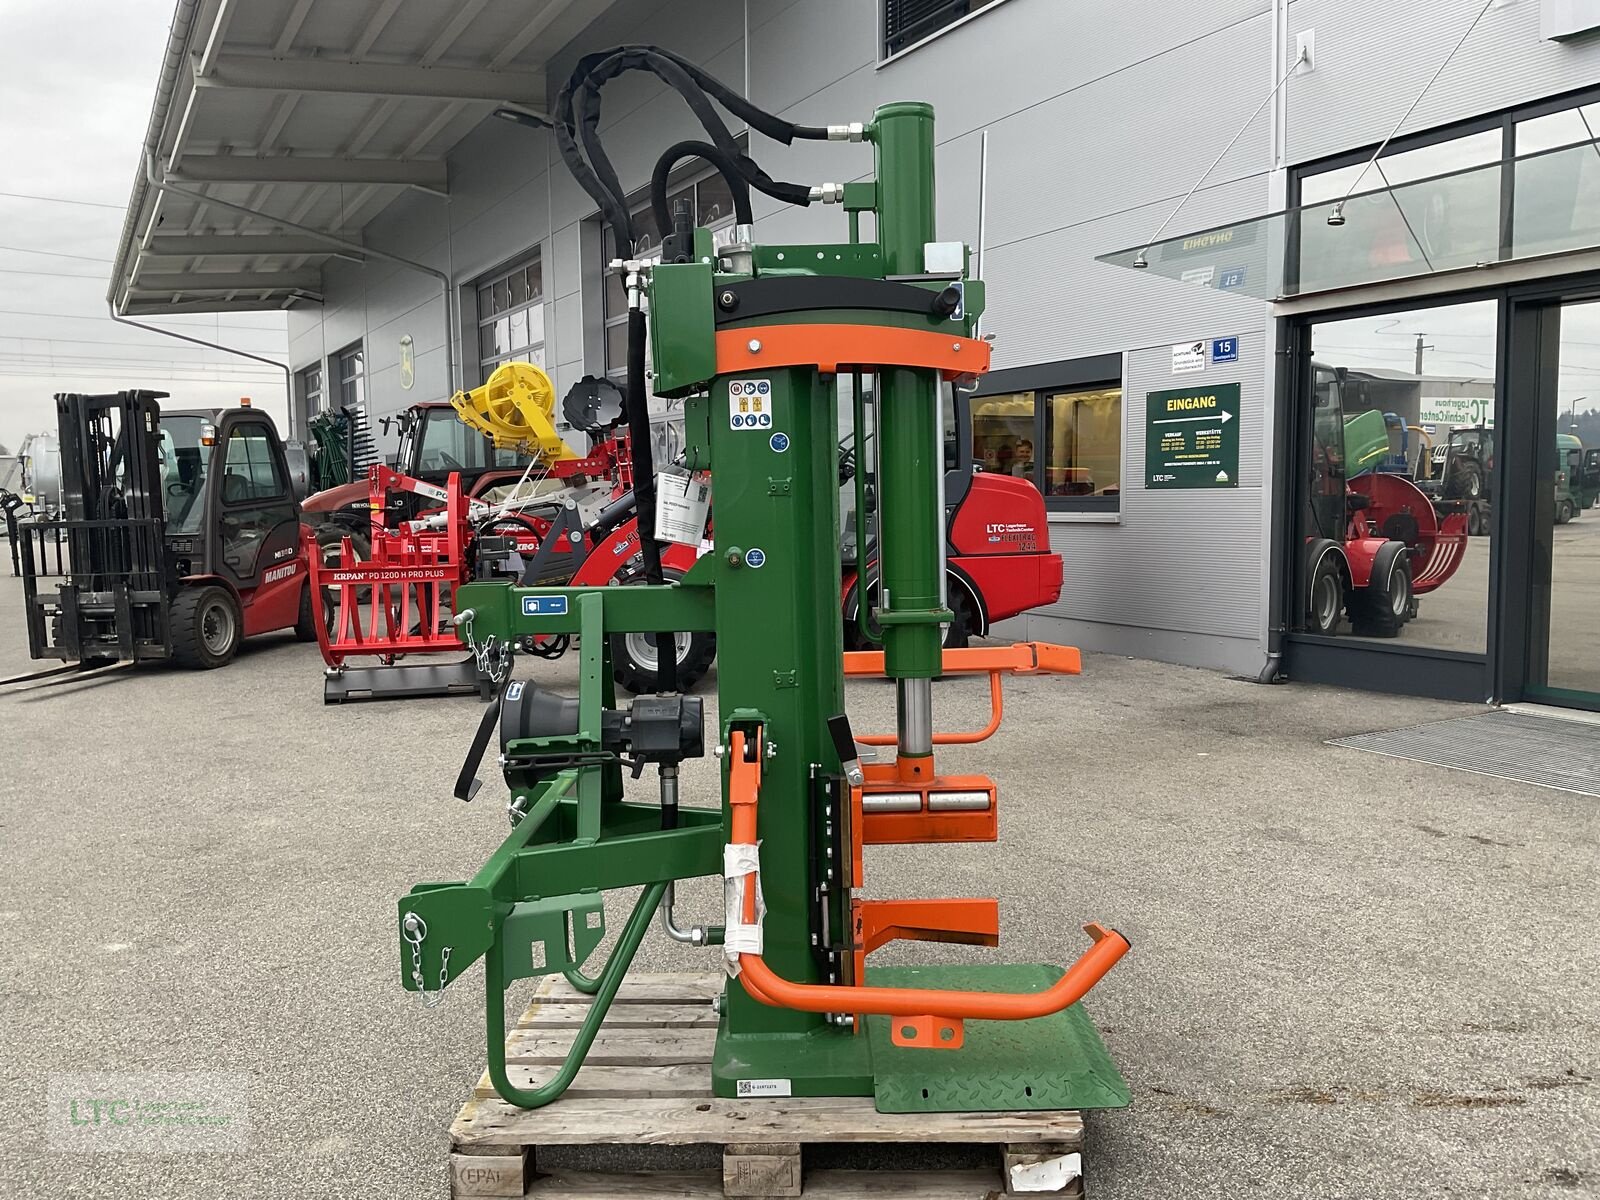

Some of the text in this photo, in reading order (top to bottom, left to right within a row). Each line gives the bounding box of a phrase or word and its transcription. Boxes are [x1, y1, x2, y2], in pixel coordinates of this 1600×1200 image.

[1218, 341, 1231, 353] 15
[1167, 396, 1216, 411] EINGANG
[986, 524, 1005, 533] LTC
[264, 563, 297, 584] MANITOU
[381, 571, 400, 579] 1200
[408, 570, 424, 578] PRO
[425, 569, 445, 577] PLUS
